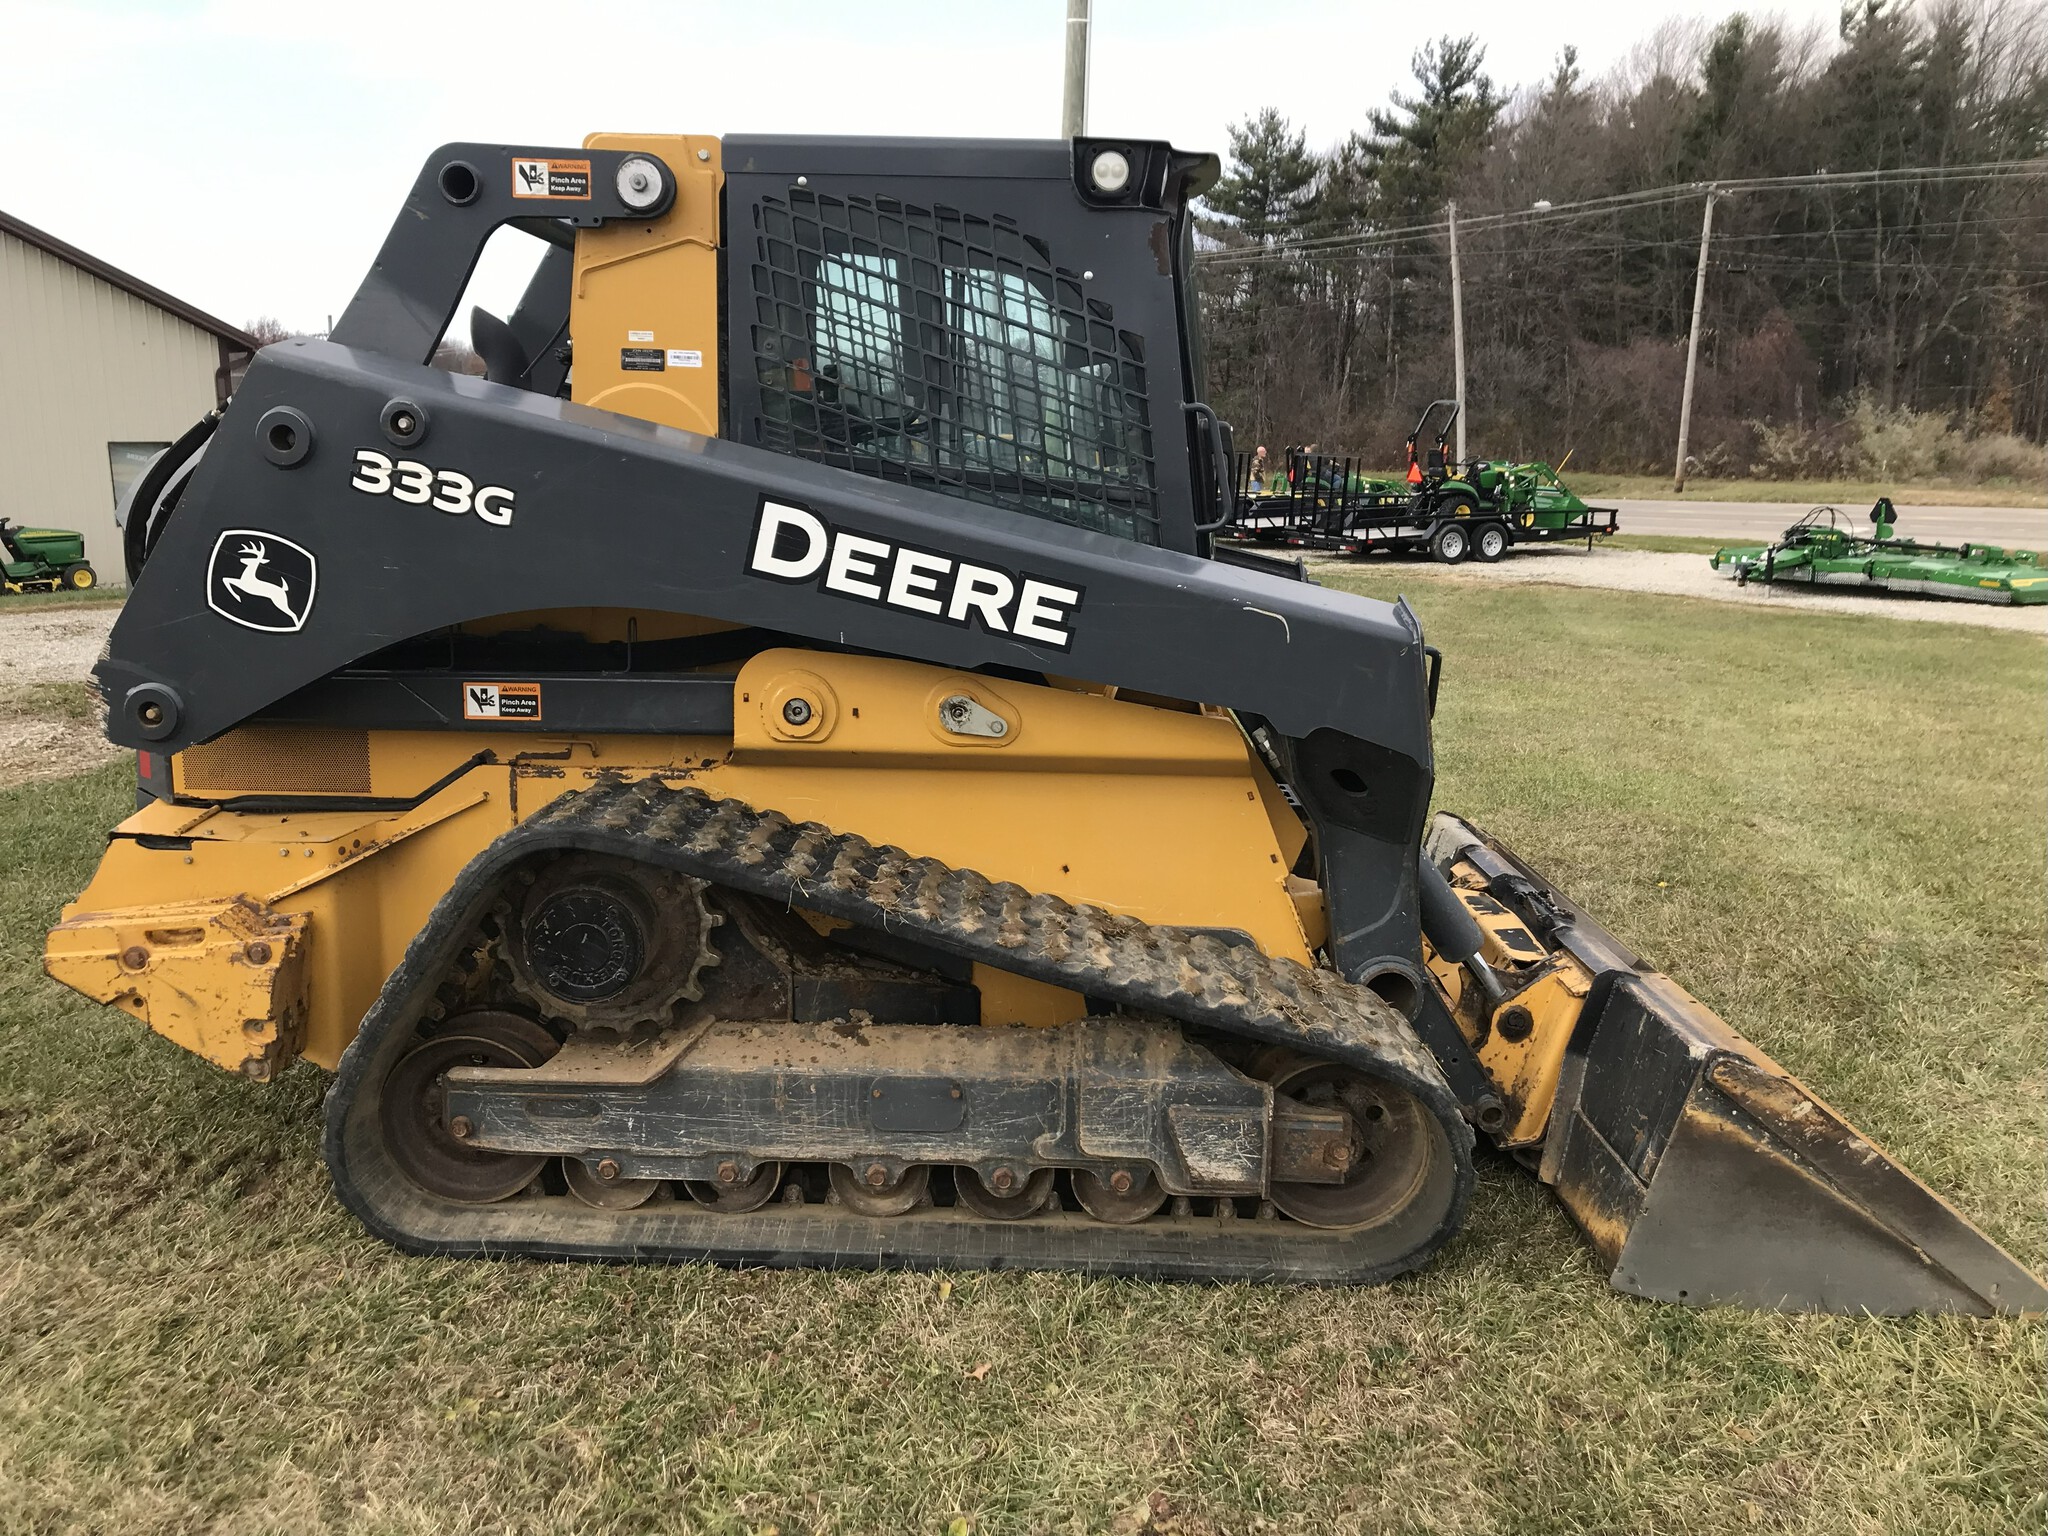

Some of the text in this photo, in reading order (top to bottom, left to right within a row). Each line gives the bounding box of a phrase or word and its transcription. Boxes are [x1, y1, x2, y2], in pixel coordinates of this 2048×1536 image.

[550, 176, 570, 184] Pinch
[352, 450, 515, 526] 333G
[751, 501, 1079, 646] DEERE
